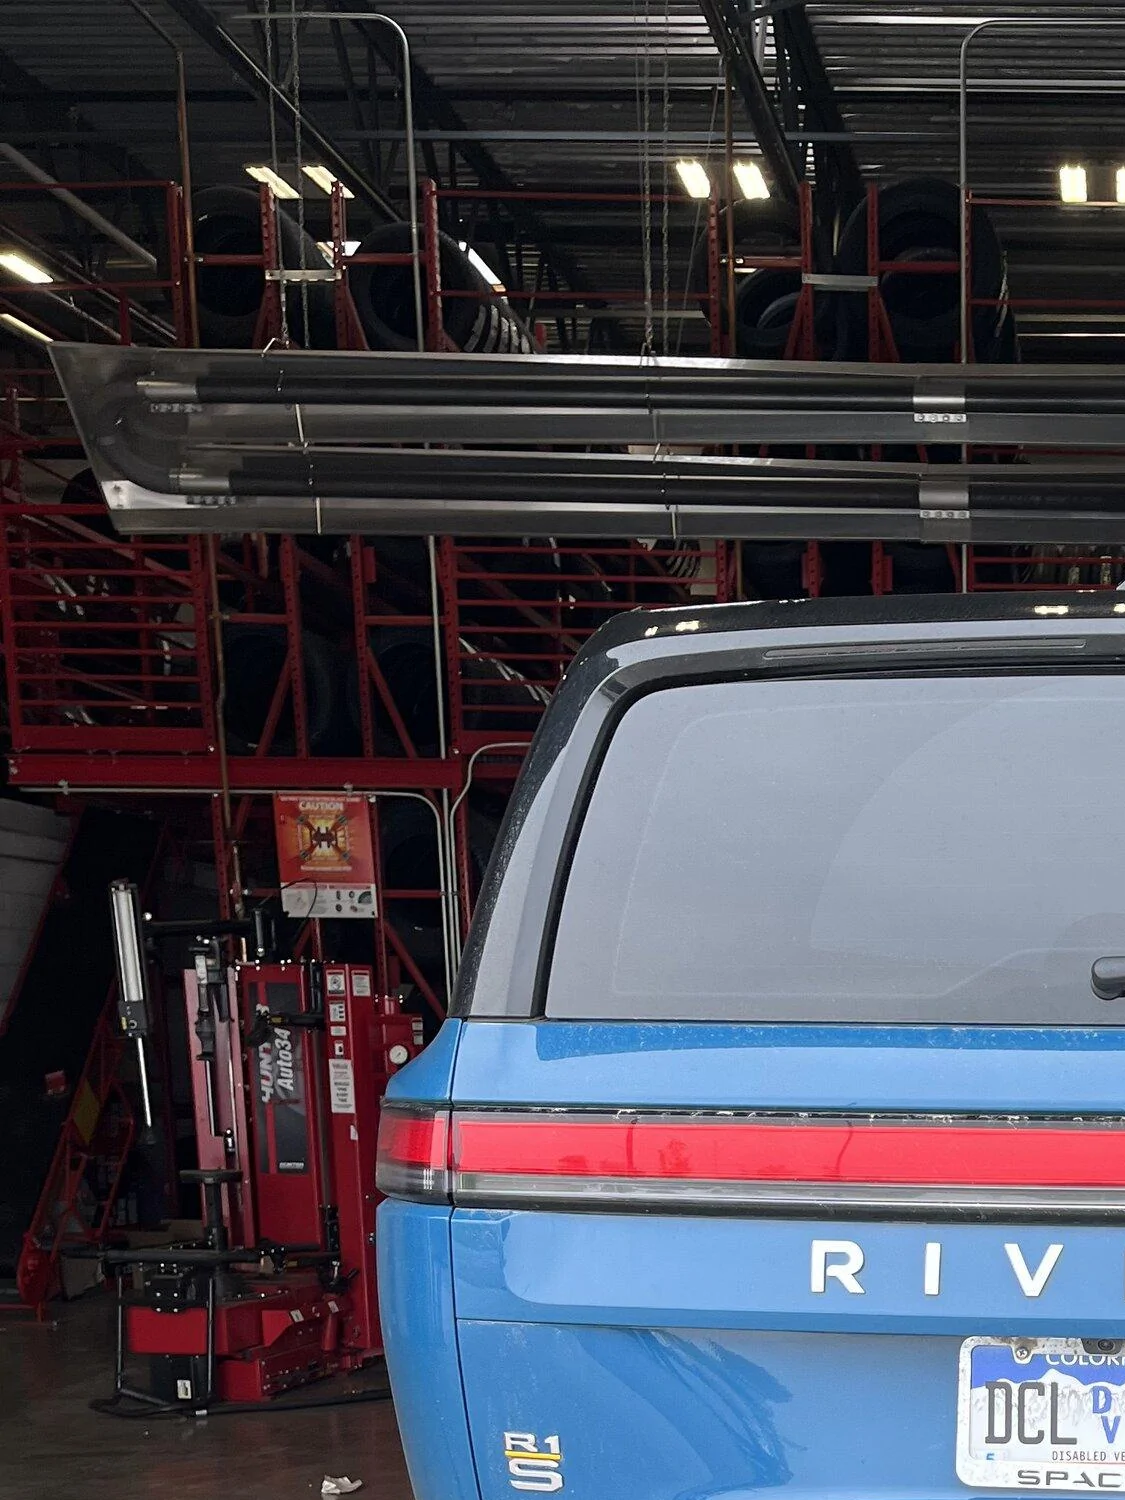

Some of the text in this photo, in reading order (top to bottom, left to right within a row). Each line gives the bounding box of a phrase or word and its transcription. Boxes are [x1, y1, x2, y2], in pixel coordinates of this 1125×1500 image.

[299, 801, 344, 811] CAUTION
[273, 1027, 294, 1092] Auto34
[985, 1381, 1077, 1446] DCL
[503, 1432, 560, 1455] R1
[1051, 1450, 1107, 1461] DISABLED
